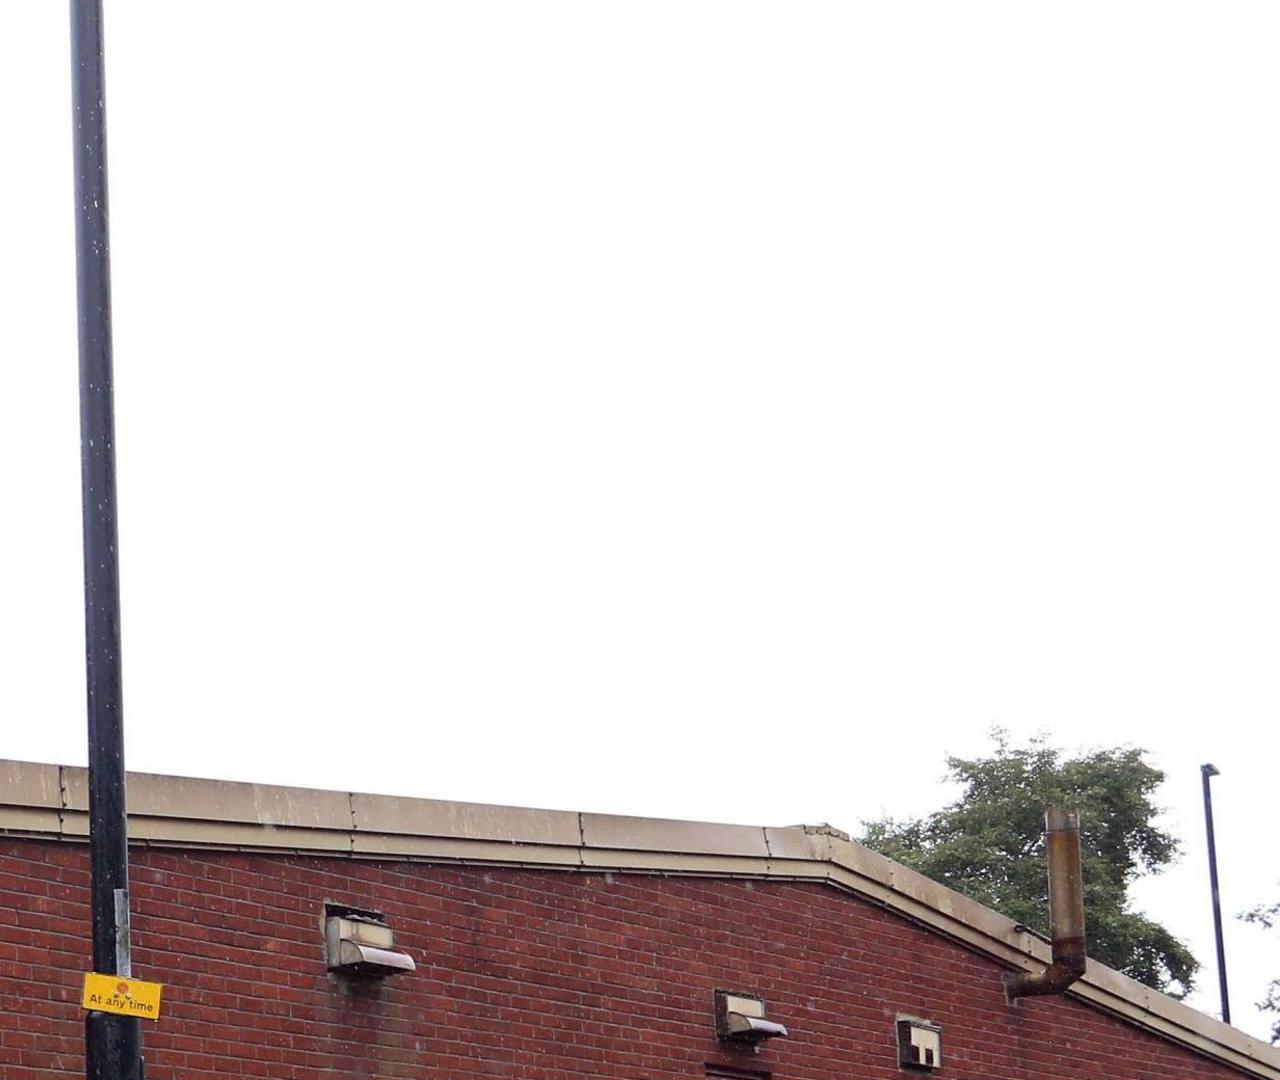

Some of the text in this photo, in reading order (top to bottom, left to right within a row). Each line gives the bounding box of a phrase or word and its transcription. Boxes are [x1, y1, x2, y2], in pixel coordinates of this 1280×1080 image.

[90, 994, 154, 1012] At any time
